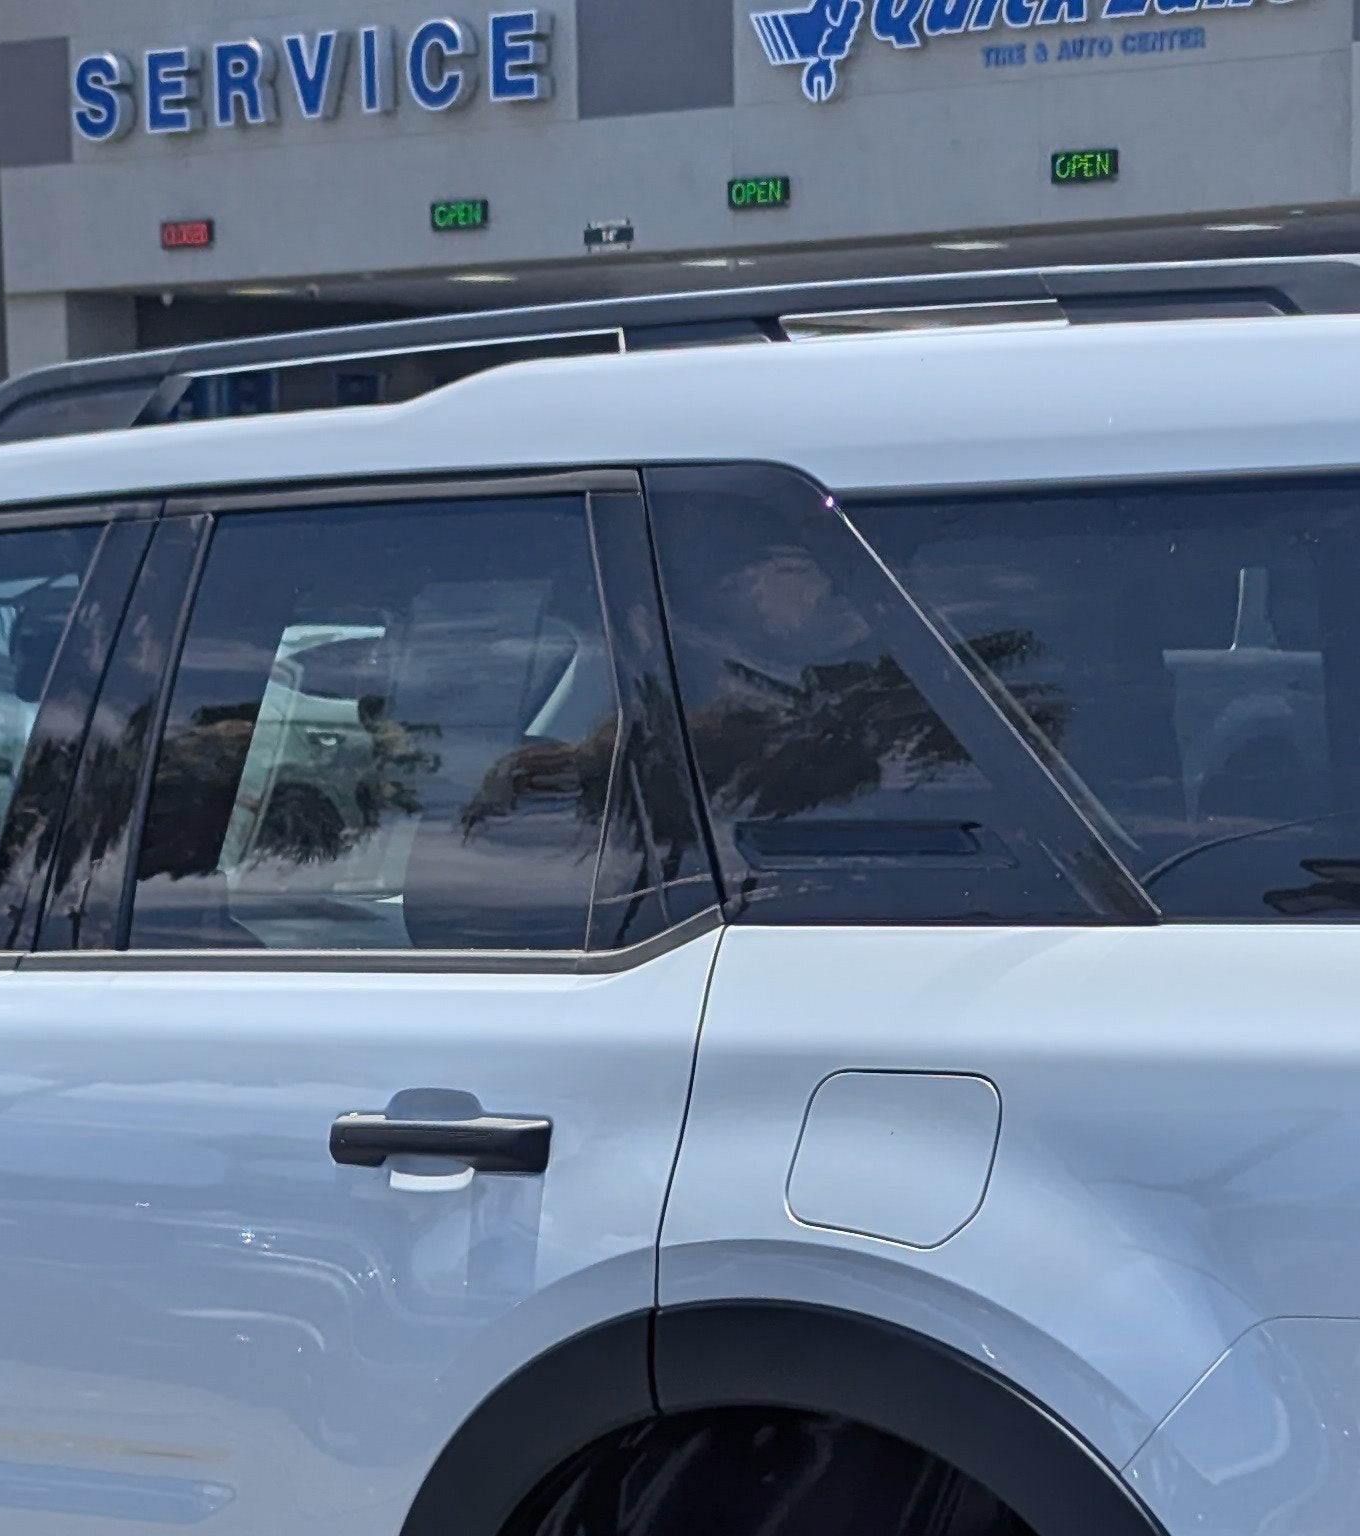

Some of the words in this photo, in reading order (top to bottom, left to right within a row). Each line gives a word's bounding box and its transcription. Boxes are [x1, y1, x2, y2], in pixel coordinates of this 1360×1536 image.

[1056, 35, 1114, 62] AUTO
[1120, 26, 1206, 55] CENTER
[73, 9, 539, 142] SERVICE
[1055, 152, 1110, 179] OPEN
[731, 180, 782, 205] OPEN
